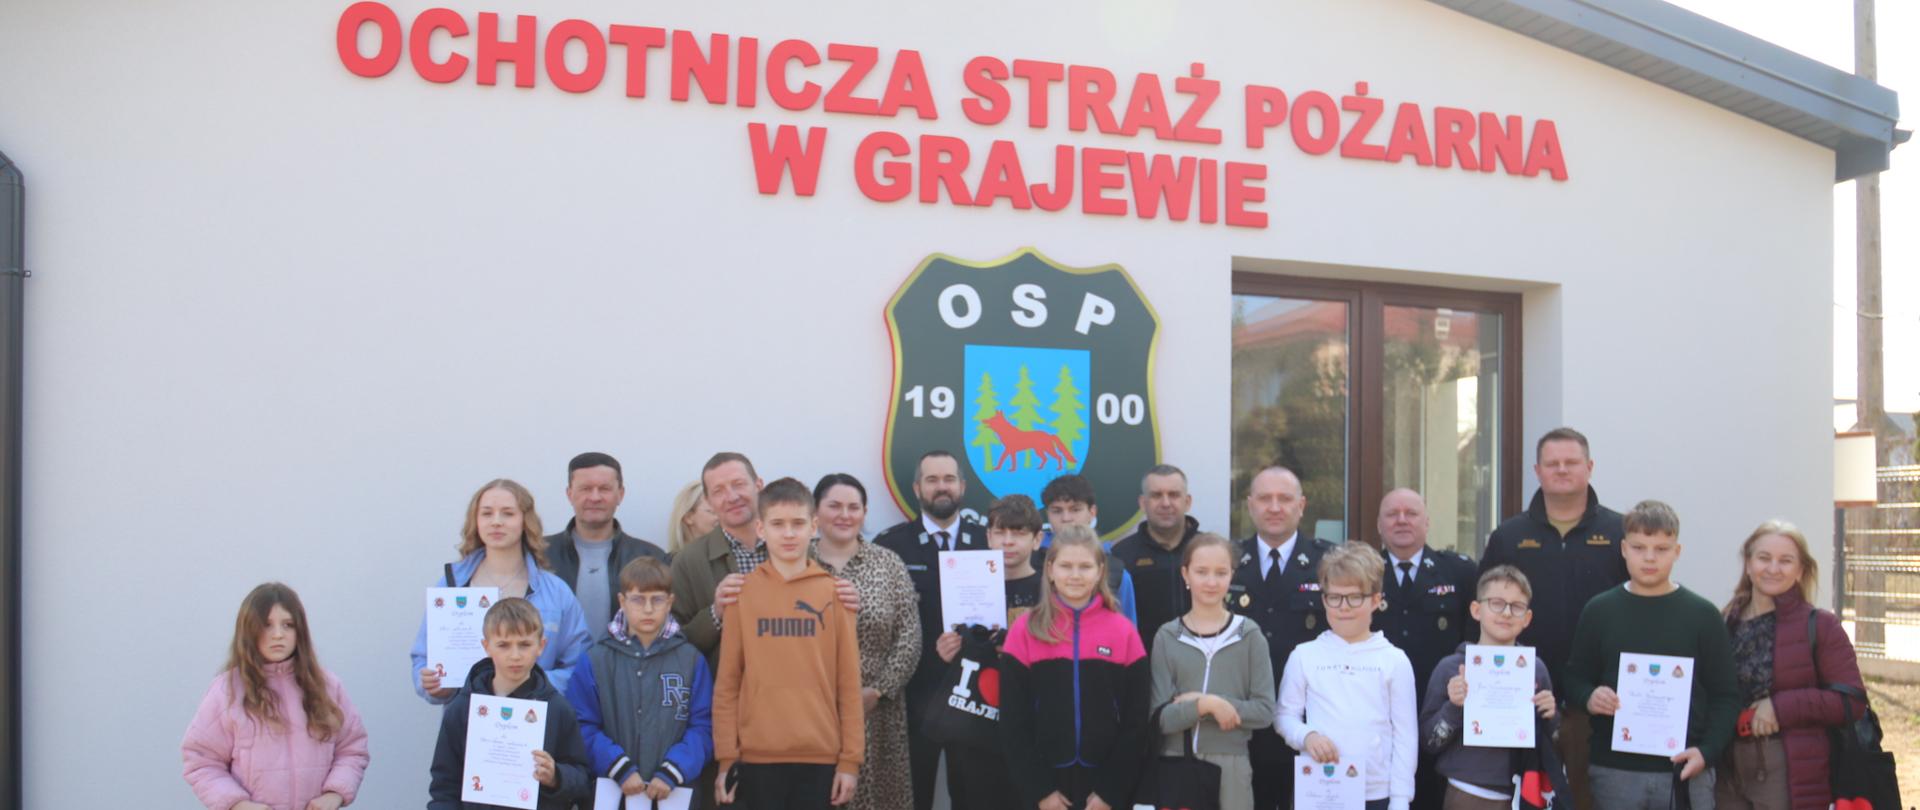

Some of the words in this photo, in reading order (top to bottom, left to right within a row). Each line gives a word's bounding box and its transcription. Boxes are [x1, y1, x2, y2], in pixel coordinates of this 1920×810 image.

[336, 0, 939, 121] OCHOTNICZA
[960, 55, 1223, 145] STRAŻ
[1245, 81, 1569, 181] POŻARNA
[747, 122, 828, 197] W
[854, 131, 1269, 229] GRAJEWIE
[904, 385, 956, 419] 19
[1096, 392, 1145, 426] 00
[757, 617, 816, 637] PUMA
[953, 658, 981, 698] I
